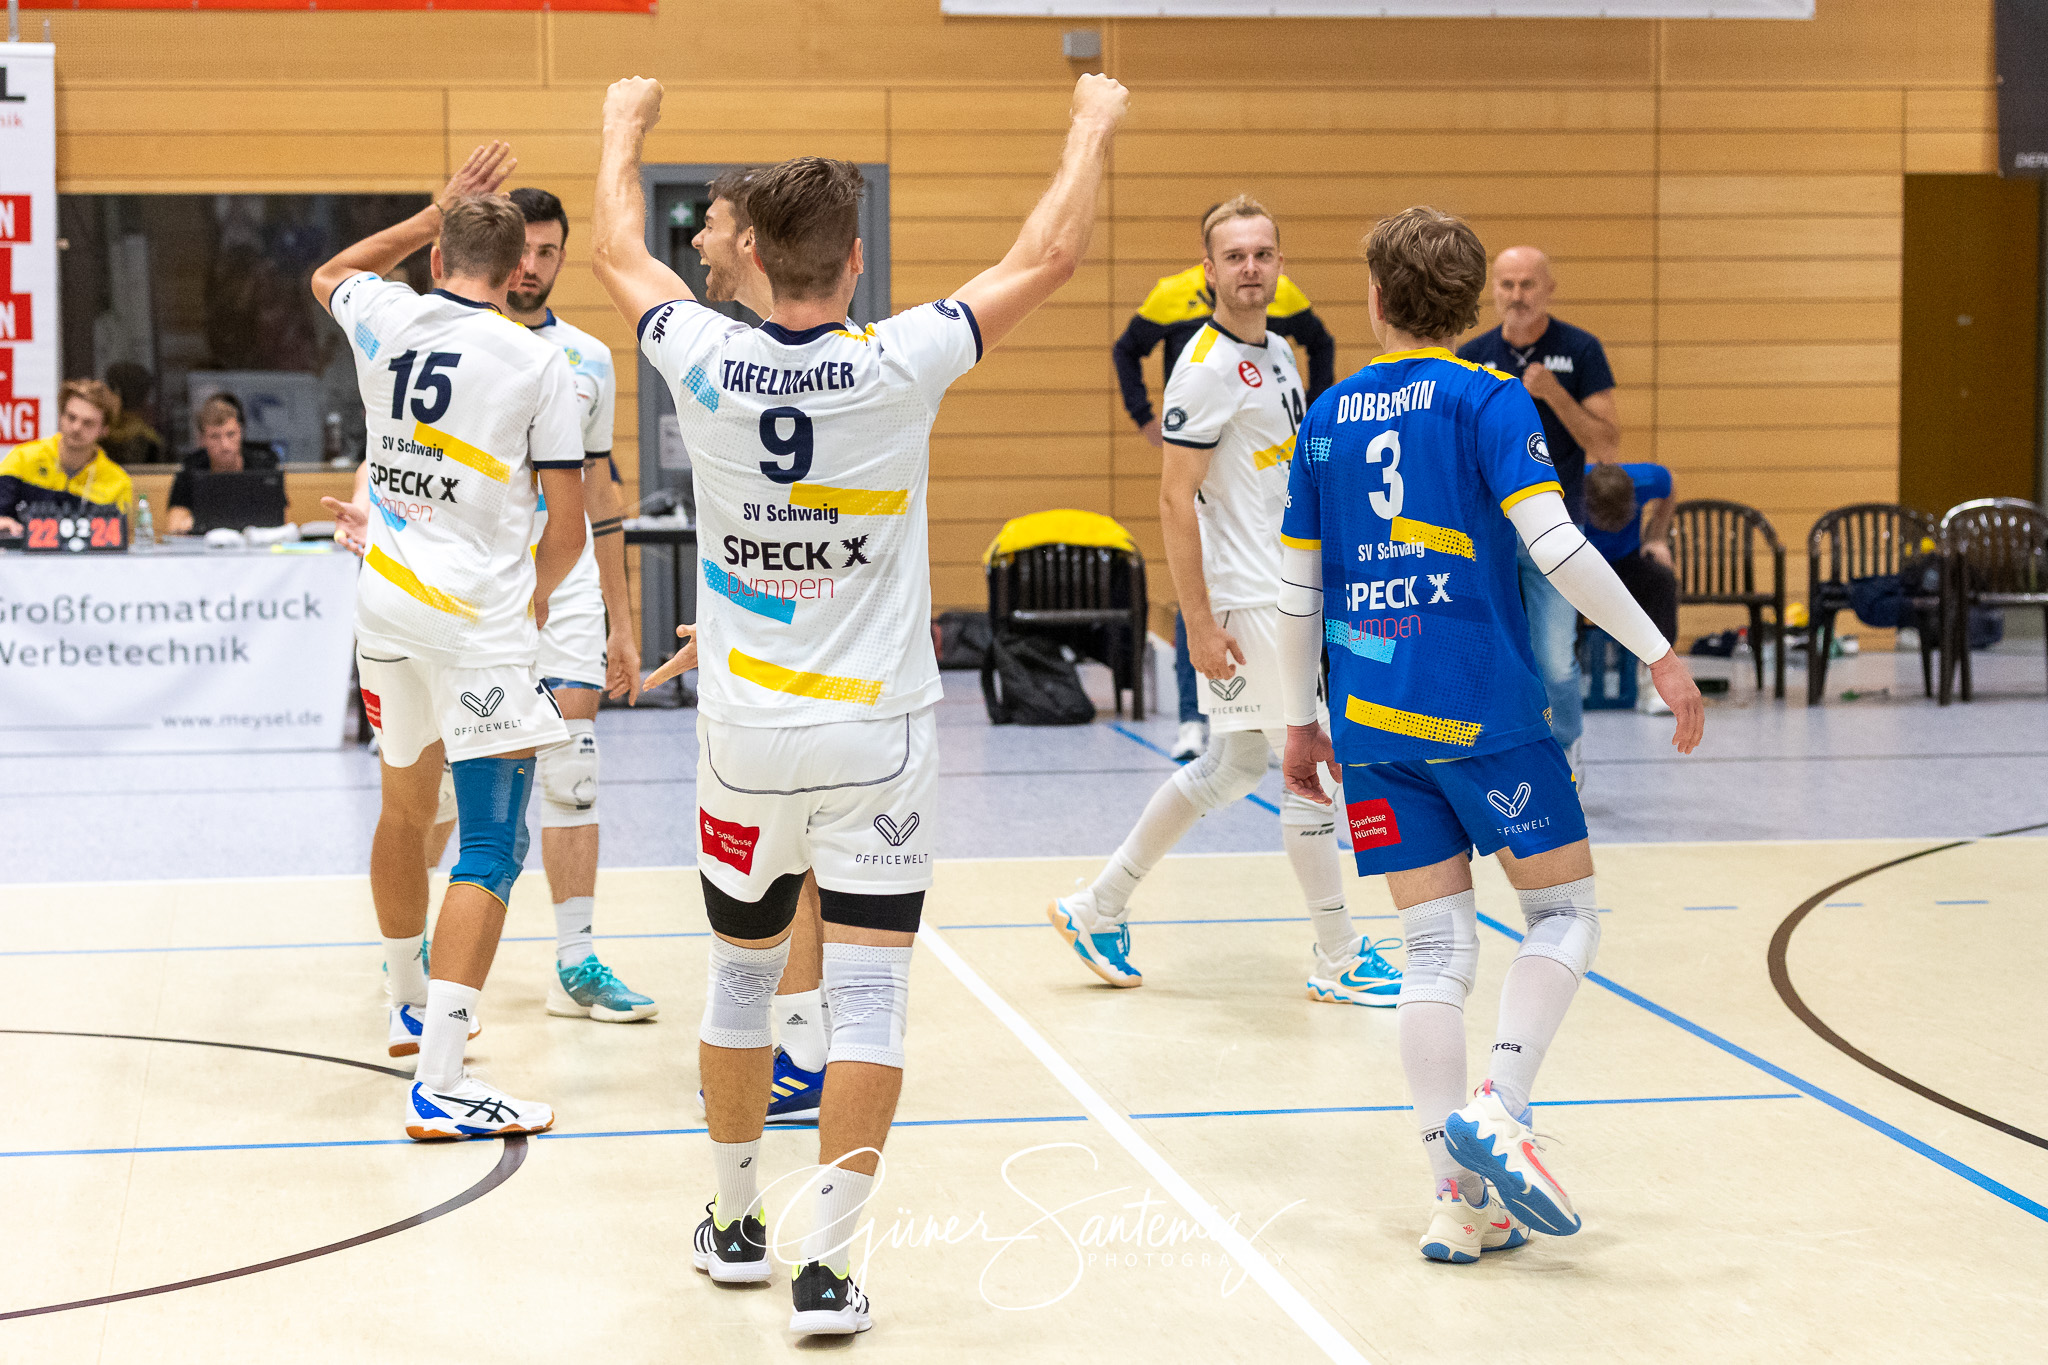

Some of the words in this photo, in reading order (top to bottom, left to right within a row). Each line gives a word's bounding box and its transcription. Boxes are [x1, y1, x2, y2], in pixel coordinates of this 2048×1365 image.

[388, 349, 462, 424] 15
[722, 360, 855, 395] TAFELMAYER
[1282, 387, 1304, 436] 14
[382, 435, 394, 450] SV
[397, 438, 444, 461] Schwaig
[758, 406, 814, 484] 9
[370, 462, 434, 499] SPECK
[1365, 429, 1404, 520] 3
[743, 502, 760, 521] SV
[766, 504, 839, 525] Schwaig
[28, 518, 59, 548] 22
[90, 517, 121, 547] 24
[723, 535, 832, 571] SPECK
[1358, 544, 1373, 562] SV
[1348, 614, 1422, 647] umpen
[454, 719, 522, 736] OFFICEWELT
[1350, 813, 1386, 829] Sparkasse
[1354, 826, 1387, 840] Nürnberg
[855, 853, 929, 865] OFFICEWELT
